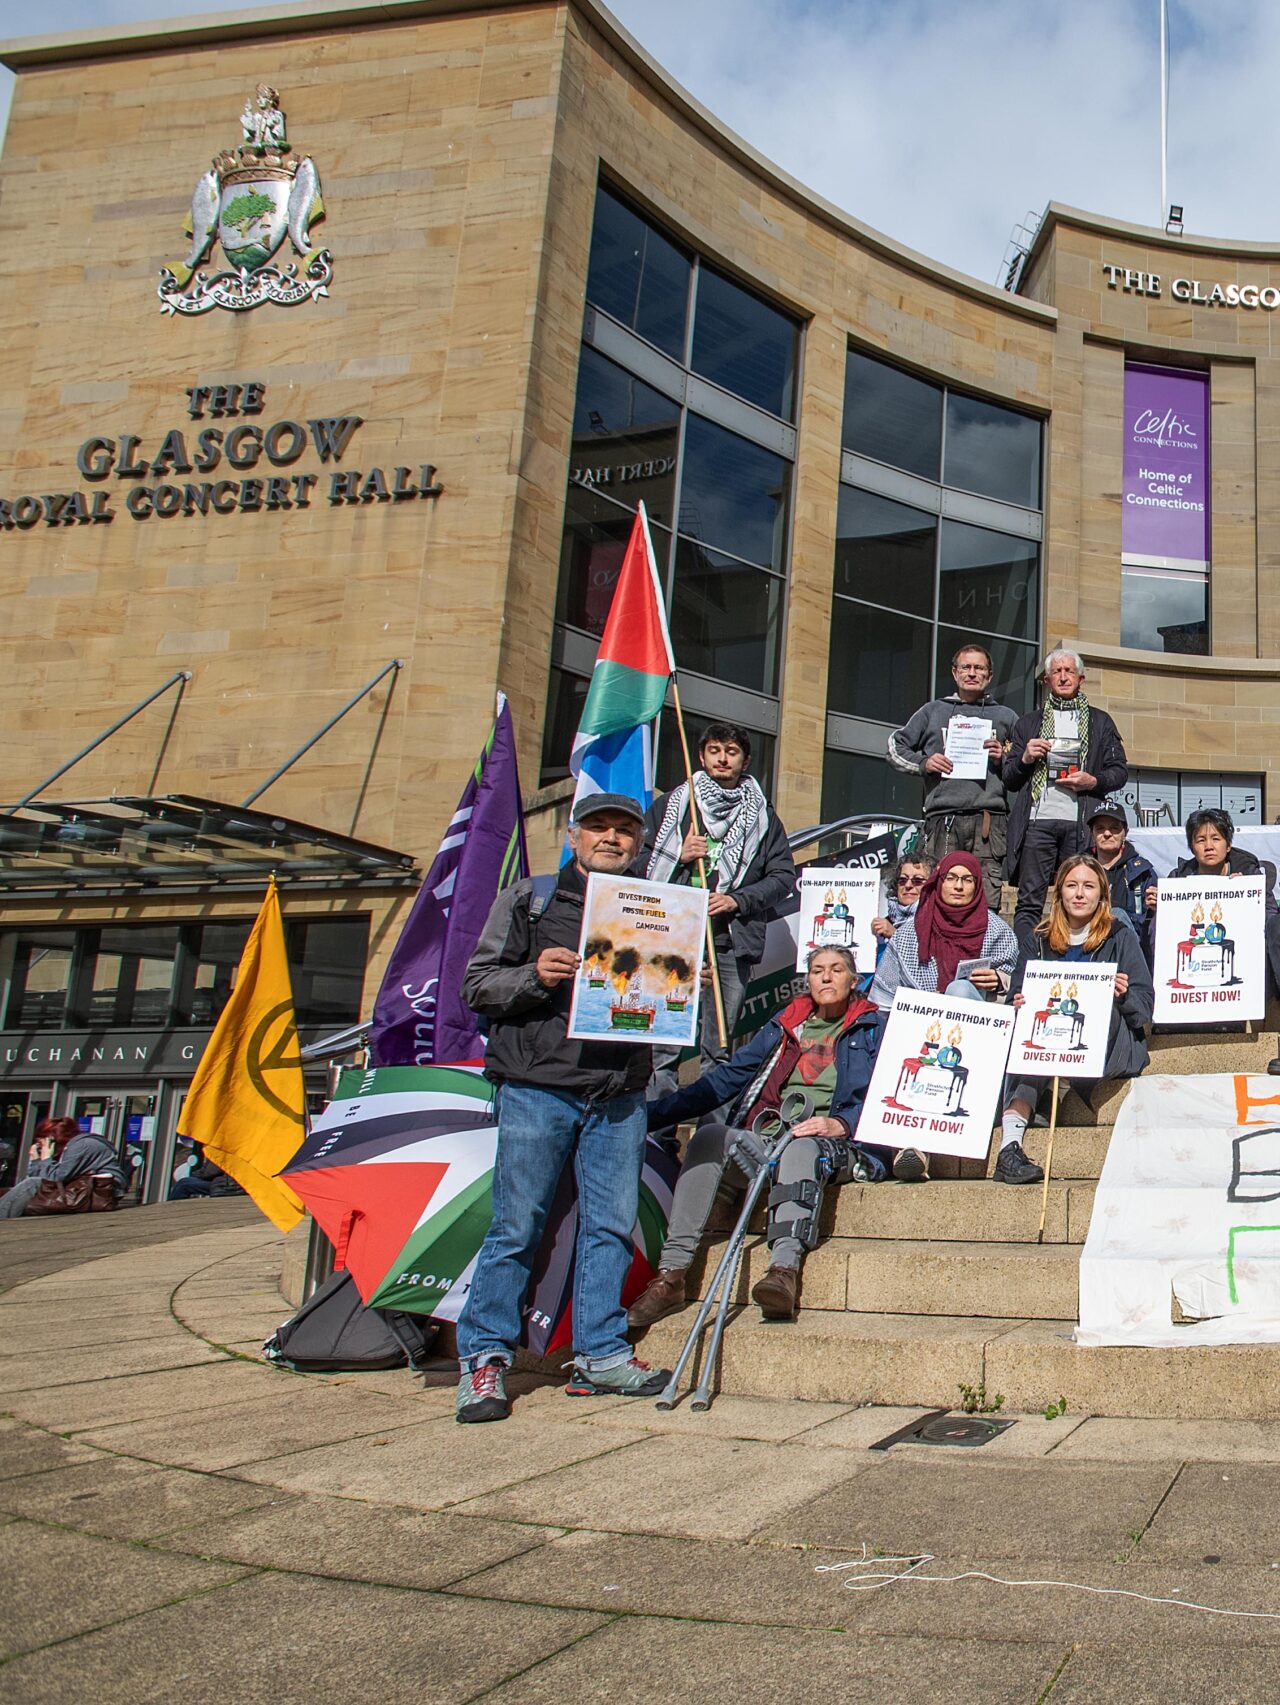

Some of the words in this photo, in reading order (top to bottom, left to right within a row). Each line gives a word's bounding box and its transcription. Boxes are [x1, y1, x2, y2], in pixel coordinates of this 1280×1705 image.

[1102, 263, 1161, 295] THE
[178, 299, 202, 310] LET
[213, 290, 262, 307] GLASGOW
[263, 280, 311, 302] FLOURISH
[186, 383, 267, 419] THE
[77, 416, 365, 481] GLASGOW
[1133, 435, 1198, 449] CONNECTIONS
[1138, 468, 1176, 483] Home
[1179, 473, 1192, 484] of
[126, 473, 318, 520] CONCERT
[328, 464, 444, 507] HALL
[1148, 482, 1183, 496] Celtic
[1126, 493, 1204, 512] Connections
[618, 892, 641, 902] DIVEST
[1161, 892, 1202, 901] UN-HAPPY
[1204, 890, 1245, 900] BIRTHDAY
[1247, 889, 1263, 898] SPF
[646, 909, 666, 918] FUELS
[635, 922, 670, 932] CAMPAIGN
[1026, 972, 1062, 980] UN-HAPPY
[1171, 991, 1208, 1004] DIVEST
[1211, 990, 1241, 1003] NOW!
[896, 1002, 944, 1019] UN-HAPPY
[945, 1010, 991, 1027] BIRTHDAY
[993, 1018, 1011, 1030] SPF
[1023, 1051, 1056, 1061] DIVEST
[1058, 1053, 1085, 1064] NOW!
[881, 1112, 927, 1128] DIVEST
[929, 1119, 965, 1135] NOW!
[314, 1131, 344, 1157] FREE
[396, 1272, 453, 1291] FROM
